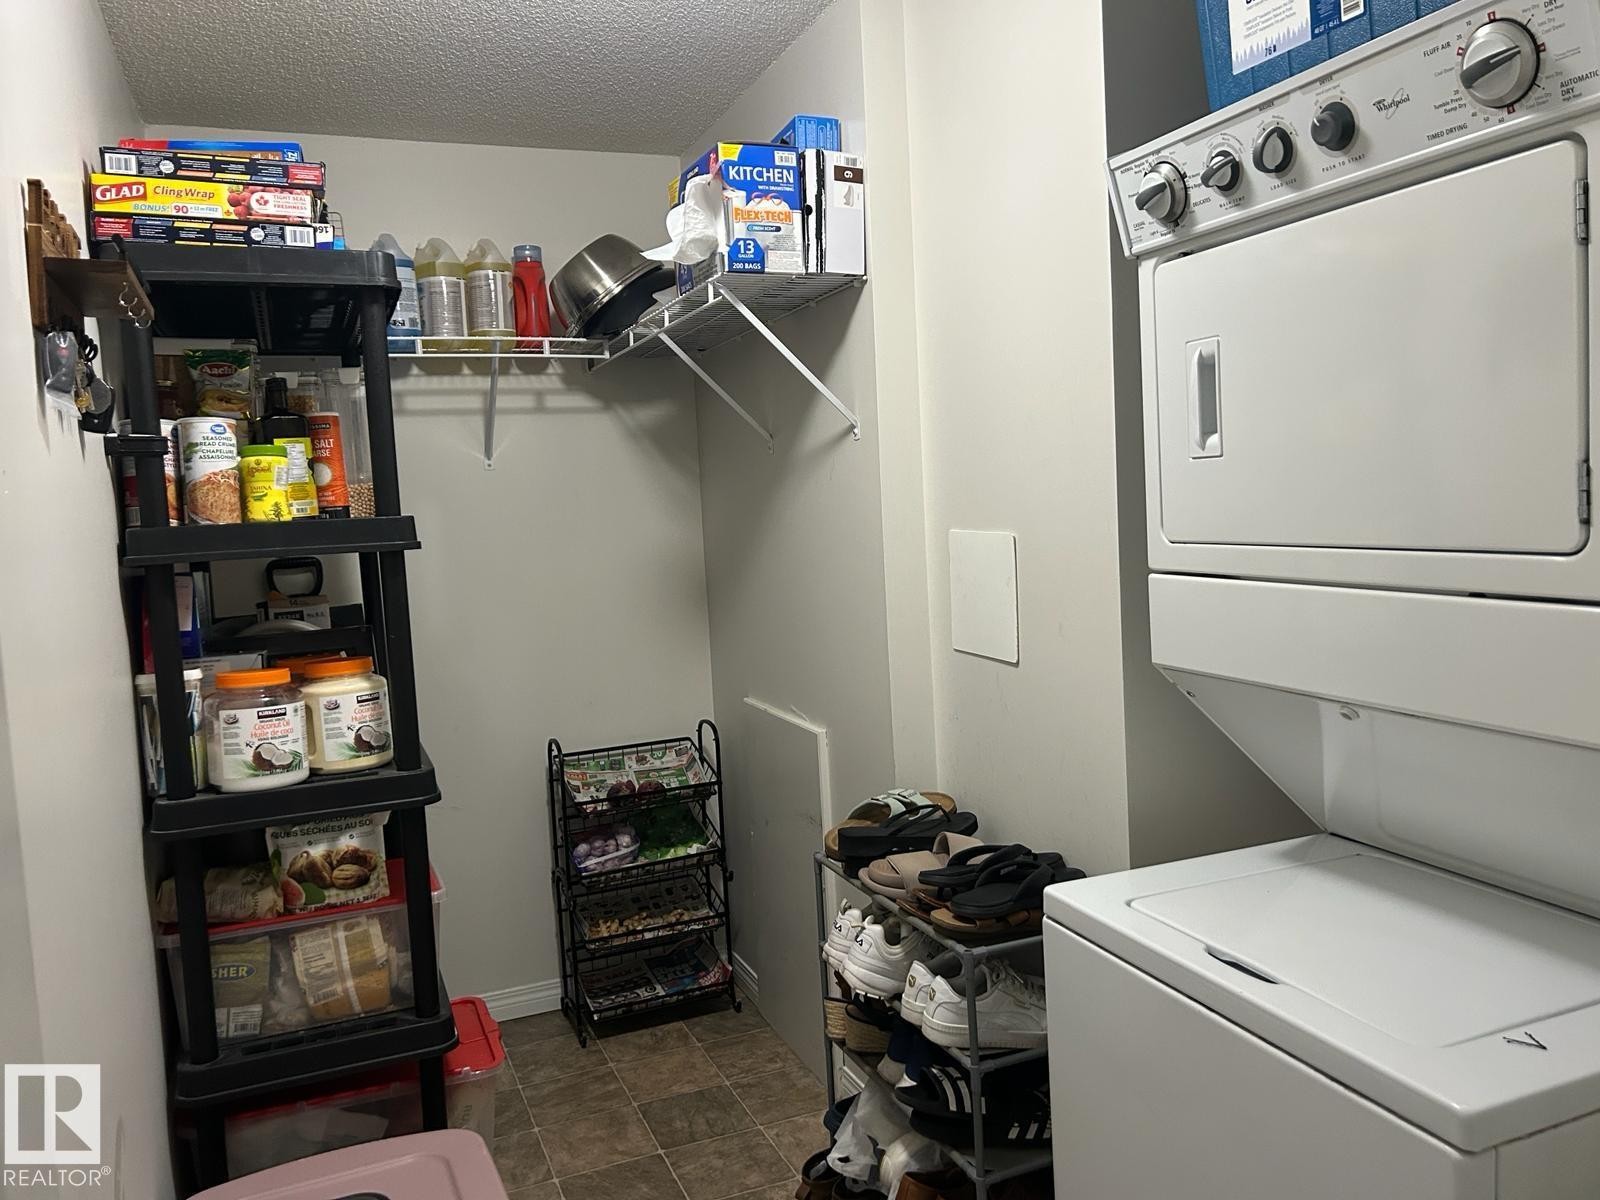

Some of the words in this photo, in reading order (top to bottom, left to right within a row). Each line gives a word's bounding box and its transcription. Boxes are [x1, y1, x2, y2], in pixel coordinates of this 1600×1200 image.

[1423, 45, 1440, 57] FLUFF
[1440, 41, 1451, 50] AIR
[1560, 69, 1600, 89] AUTOMATIC
[1561, 86, 1575, 97] DRY
[1376, 93, 1410, 112] Whirlpool
[1426, 130, 1445, 141] TIMED
[1445, 122, 1468, 136] DRYING
[1321, 164, 1336, 173] PUSH
[1348, 153, 1366, 164] START
[728, 165, 794, 184] KITCHEN
[95, 184, 145, 201] GLAD
[1269, 182, 1284, 191] LOAD
[173, 204, 189, 215] 90
[273, 203, 307, 211] FRESHNESS
[737, 240, 755, 254] 13
[744, 262, 762, 270] BAGS
[314, 438, 335, 448] SALT
[313, 449, 332, 457] ARSE
[258, 708, 287, 717] KIRKLAND
[254, 721, 281, 731] Coconut
[282, 719, 291, 727] Oil
[250, 730, 269, 738] Huile
[270, 728, 280, 736] de
[280, 727, 294, 735] coco
[300, 823, 344, 837] SÉCHÉES
[344, 821, 357, 830] AU
